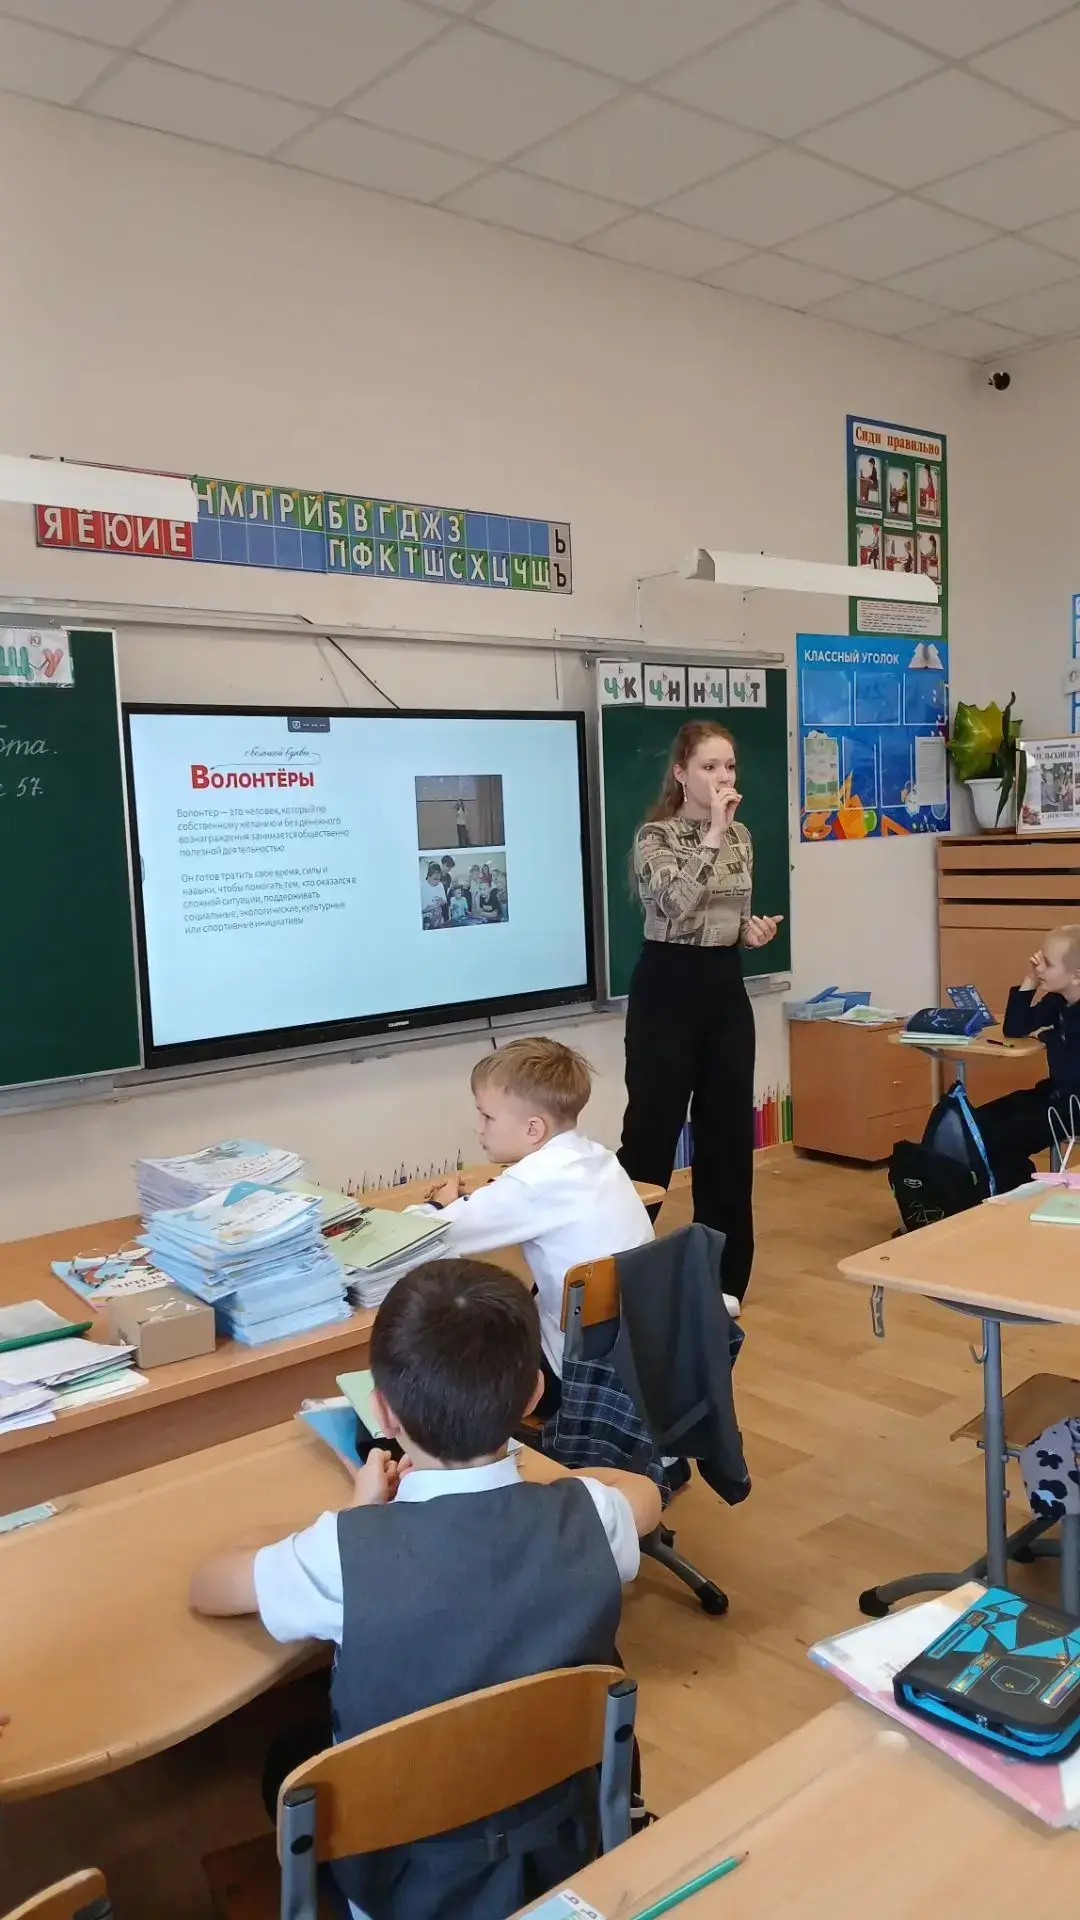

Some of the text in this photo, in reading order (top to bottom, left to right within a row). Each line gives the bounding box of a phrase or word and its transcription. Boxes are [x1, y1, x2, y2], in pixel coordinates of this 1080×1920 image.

[855, 426, 940, 455] Сиди правильно
[804, 649, 900, 665] КЛАССНЫЙ УГОЛОК
[229, 808, 243, 816] это
[177, 820, 239, 831] собственному
[284, 818, 299, 827] без
[299, 818, 342, 828] денежного
[178, 829, 350, 844] вознаграждения занимается общественно
[179, 845, 222, 857] полезной
[181, 873, 194, 883] Он
[196, 873, 220, 882] готов
[221, 871, 254, 882] тратить
[302, 867, 322, 875] силы
[218, 883, 244, 893] чтобы
[244, 882, 283, 892] помогать
[316, 877, 351, 887] оказался
[182, 897, 221, 909] сложной
[263, 891, 321, 902] поддерживать
[302, 902, 346, 913] культурные
[184, 926, 201, 935] или
[202, 921, 253, 933] спортивные
